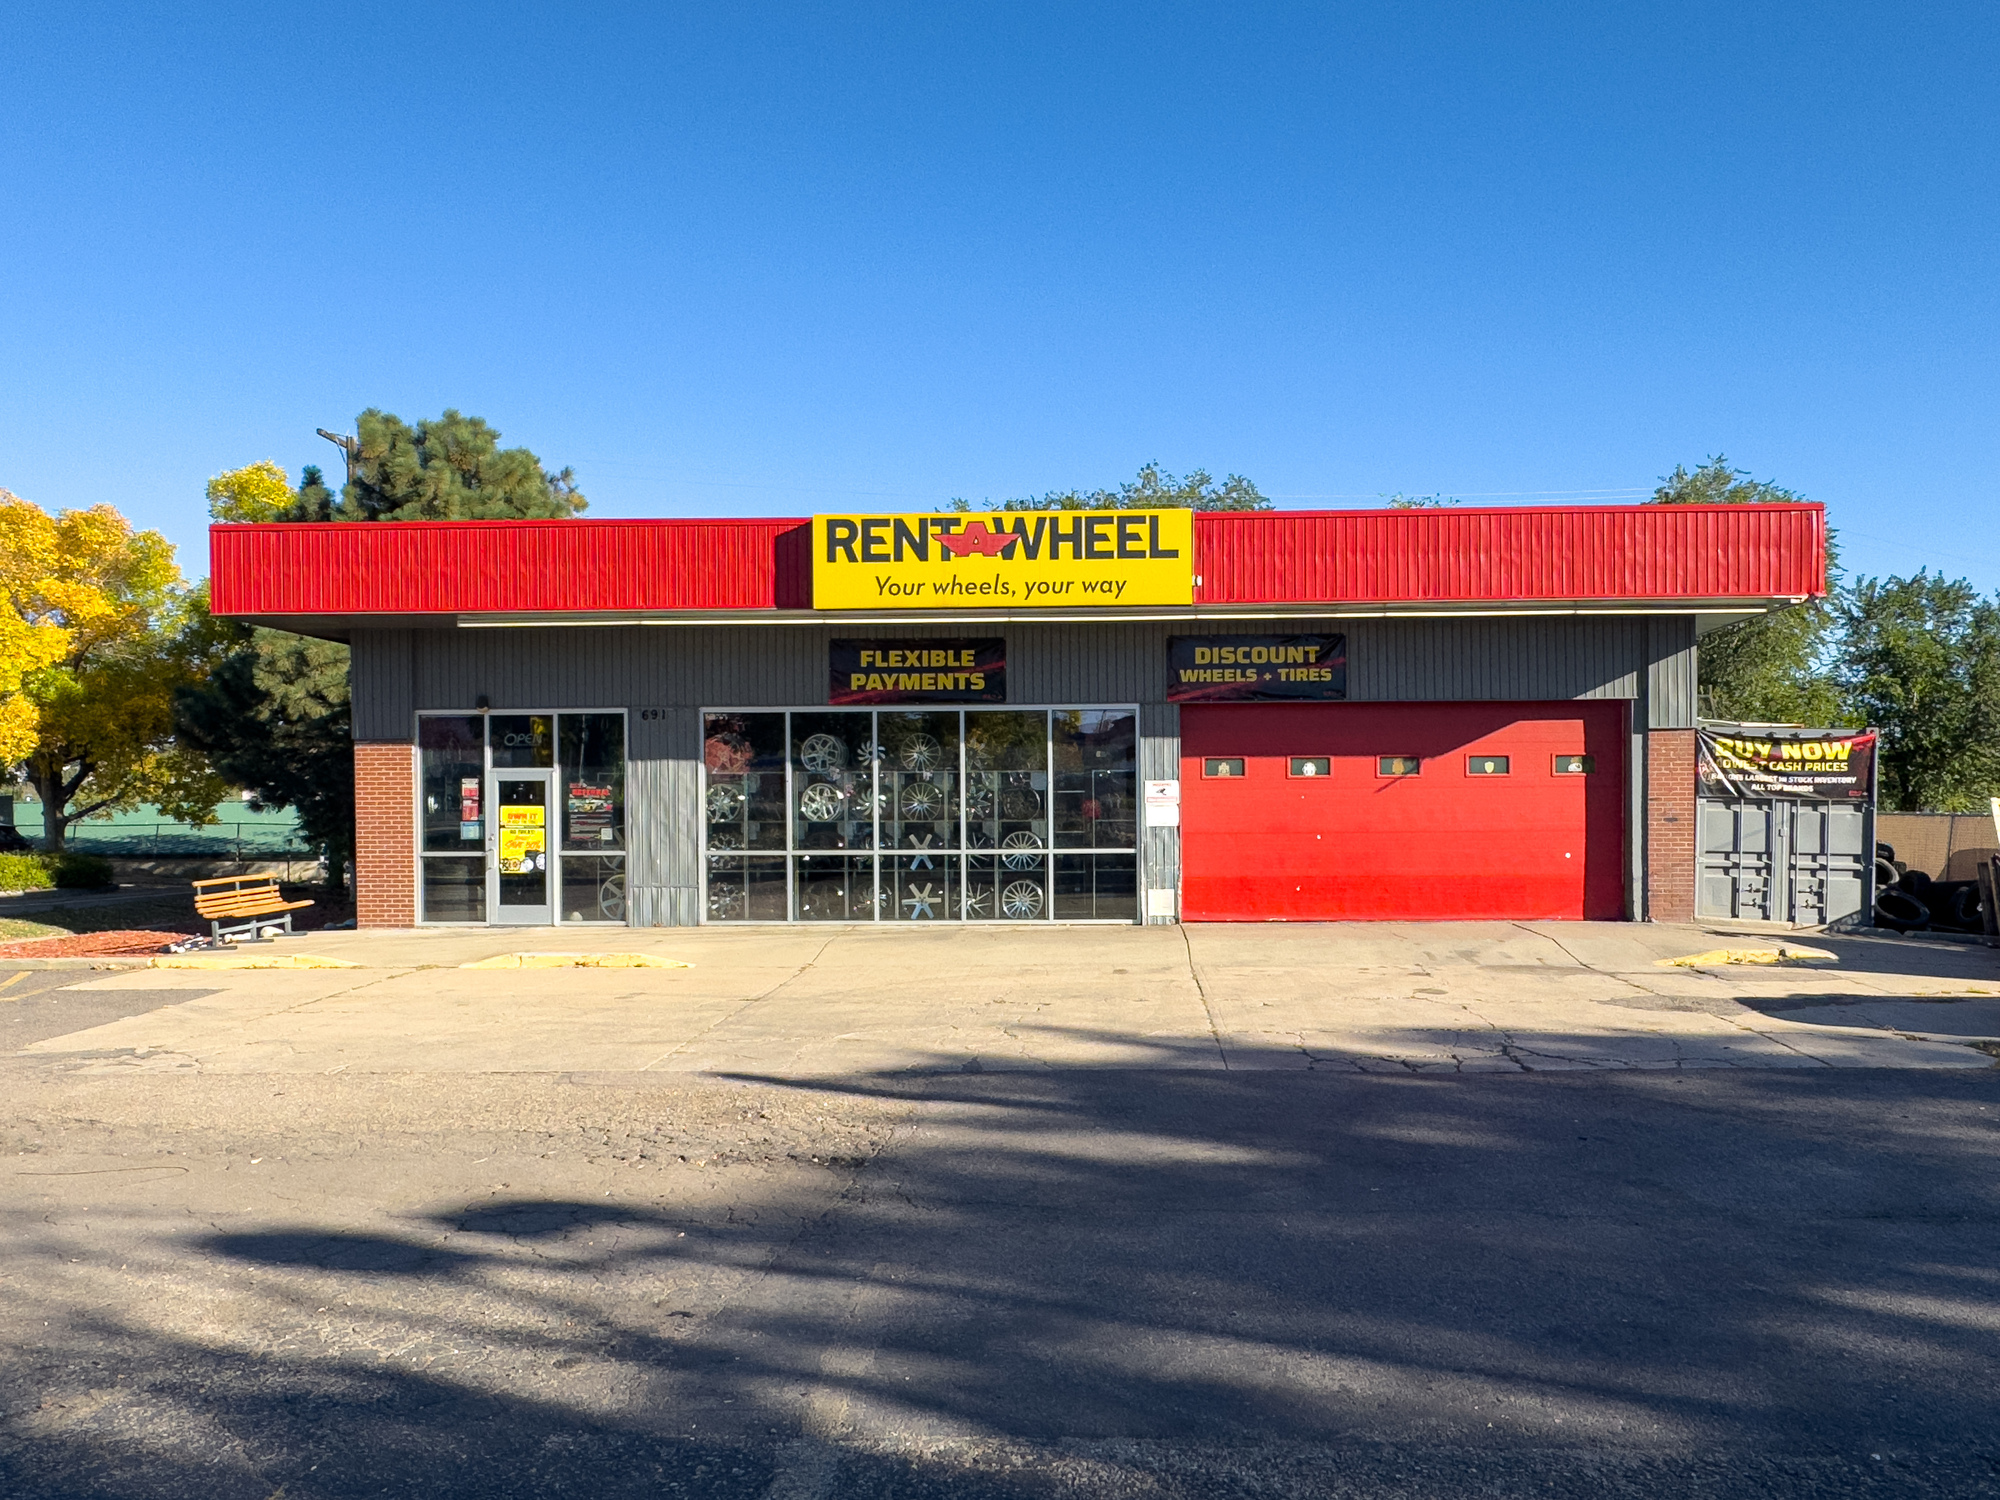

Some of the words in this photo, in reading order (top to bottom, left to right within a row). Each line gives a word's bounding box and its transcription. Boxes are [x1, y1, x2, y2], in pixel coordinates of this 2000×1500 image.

[826, 518, 962, 563] RENT
[992, 514, 1180, 561] WHEEL
[875, 576, 925, 597] Your
[932, 573, 1016, 597] wheels,
[1024, 580, 1075, 600] your
[1082, 580, 1127, 599] way
[860, 649, 976, 668] FLEXIBLE
[1194, 646, 1320, 665] DISCOUNT
[850, 672, 986, 692] PAYMENTS
[1180, 668, 1258, 683] WHEELS
[1277, 668, 1332, 682] TIRES
[641, 709, 667, 721] 691
[504, 733, 543, 746] OPEN
[1780, 742, 1852, 760] NOW
[1769, 761, 1801, 771] CASH
[1804, 762, 1848, 772] PRICES
